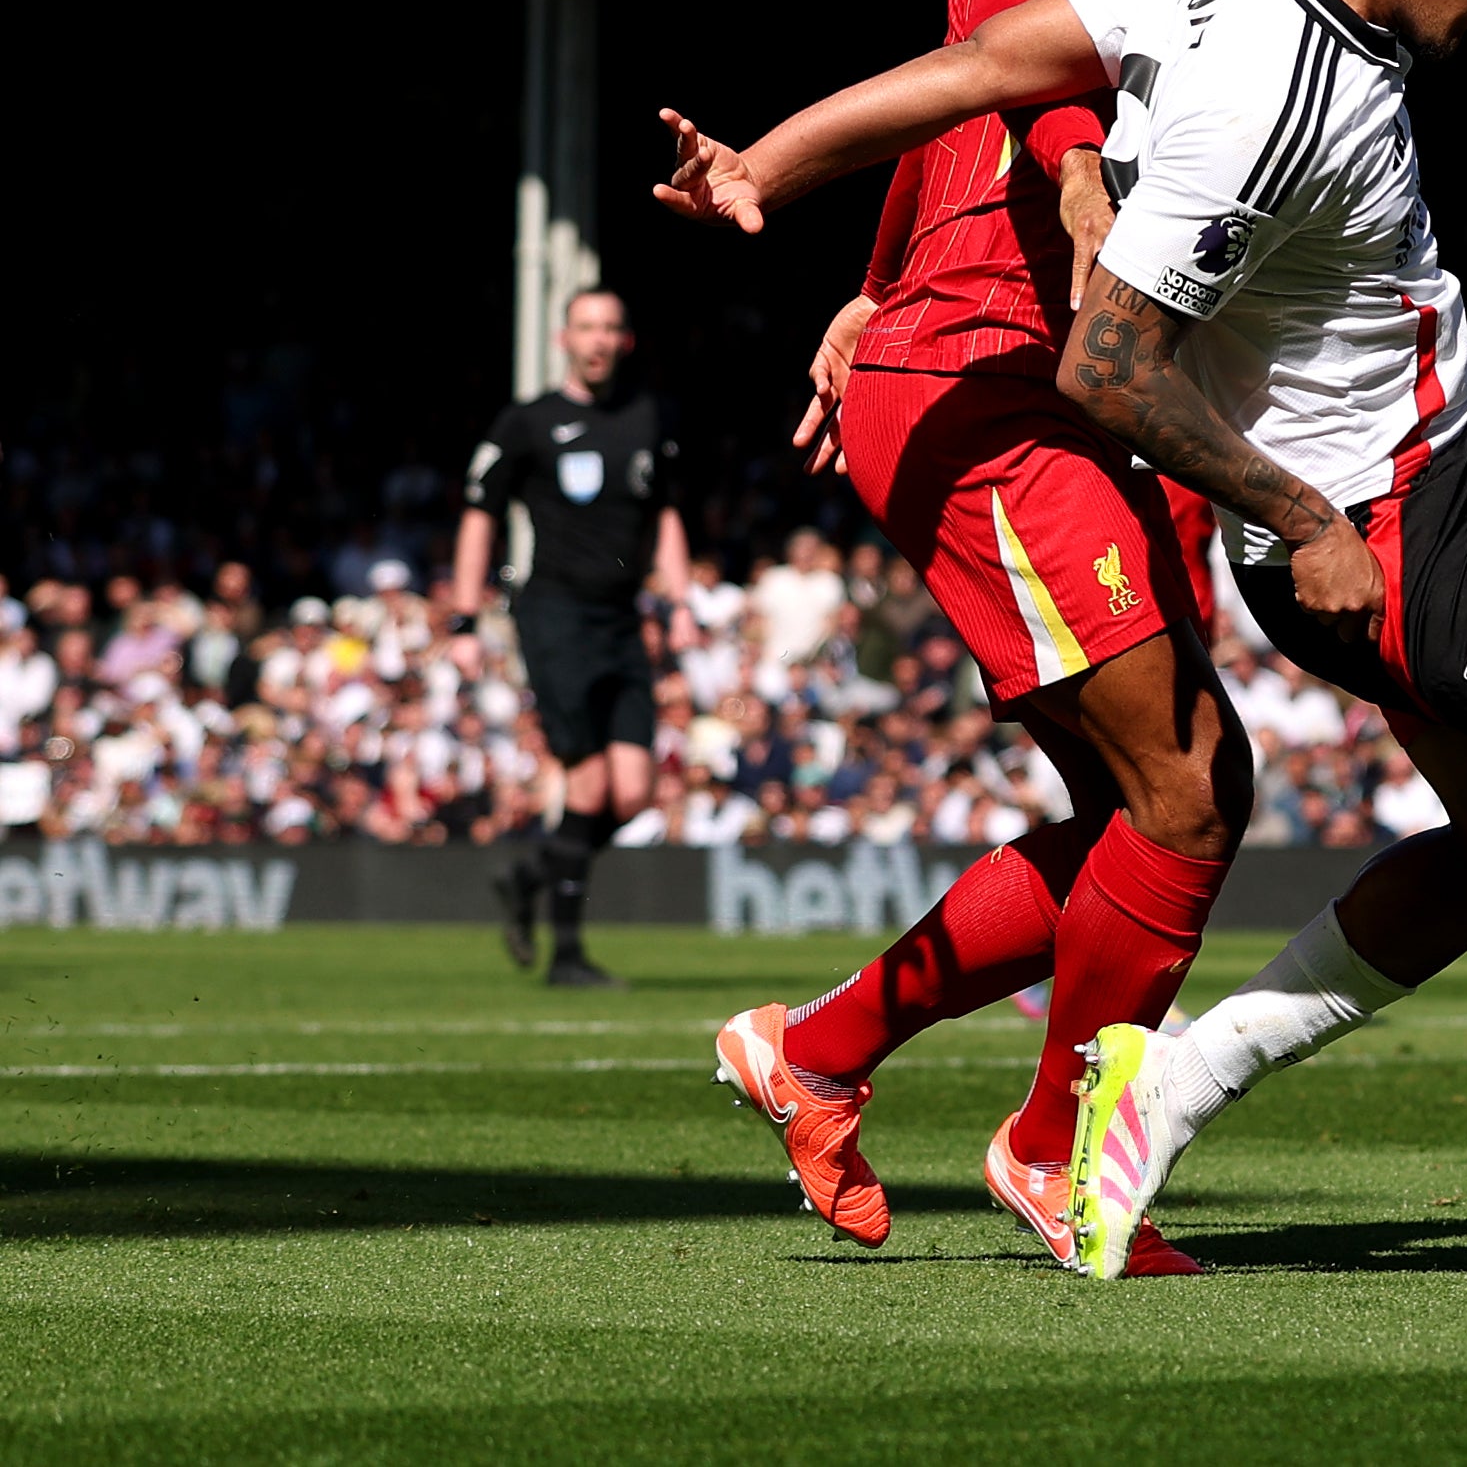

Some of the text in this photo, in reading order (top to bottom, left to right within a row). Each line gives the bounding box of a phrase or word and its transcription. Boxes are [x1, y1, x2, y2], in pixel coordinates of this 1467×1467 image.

[1105, 278, 1149, 317] RM
[1154, 278, 1179, 300] for
[1159, 266, 1217, 303] No room
[1075, 309, 1140, 391] 9
[0, 836, 298, 931] etway
